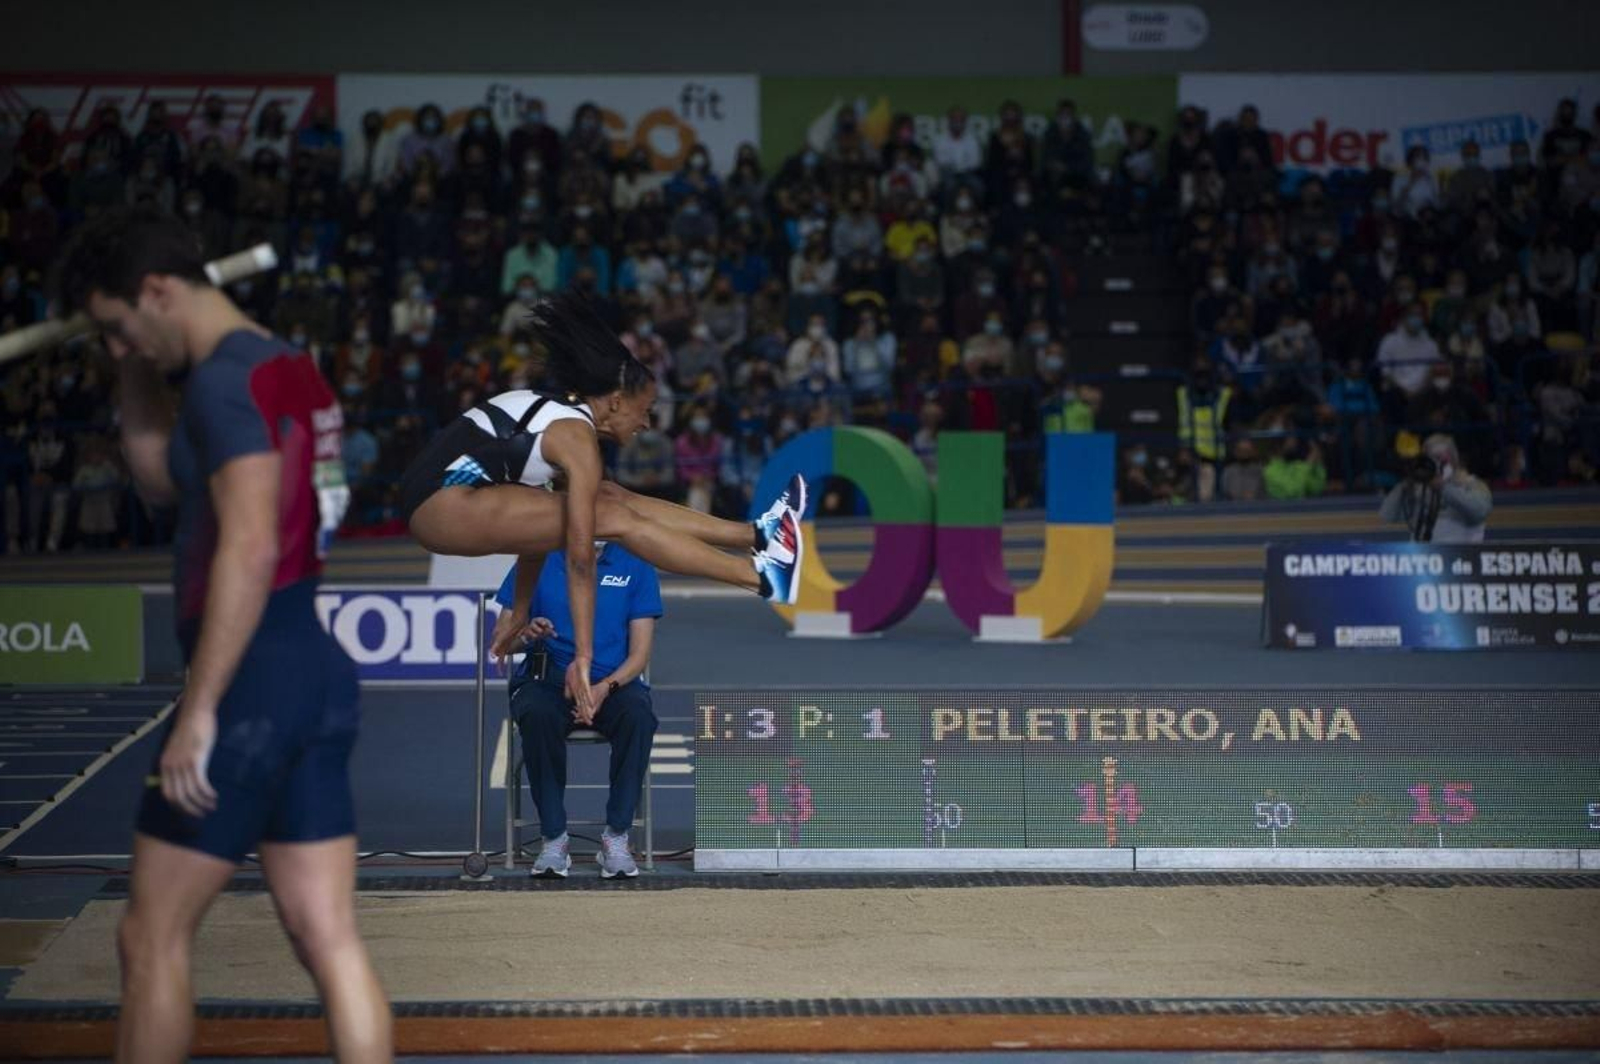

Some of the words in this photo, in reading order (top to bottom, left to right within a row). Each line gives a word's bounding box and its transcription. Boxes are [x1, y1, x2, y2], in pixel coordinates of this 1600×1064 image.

[679, 83, 725, 121] fit
[1284, 554, 1444, 576] CAMPEONATO
[1452, 557, 1473, 575] de
[1480, 547, 1584, 576] ESPAÑA
[1416, 582, 1578, 614] OURENSE
[699, 705, 733, 739] I:
[747, 708, 777, 739] 3
[799, 705, 834, 739] P:
[862, 708, 891, 739] 1
[931, 708, 1235, 750] PELETEIRO,
[1252, 707, 1361, 741] ANA
[1254, 802, 1294, 829] 50
[1408, 782, 1479, 824] 15
